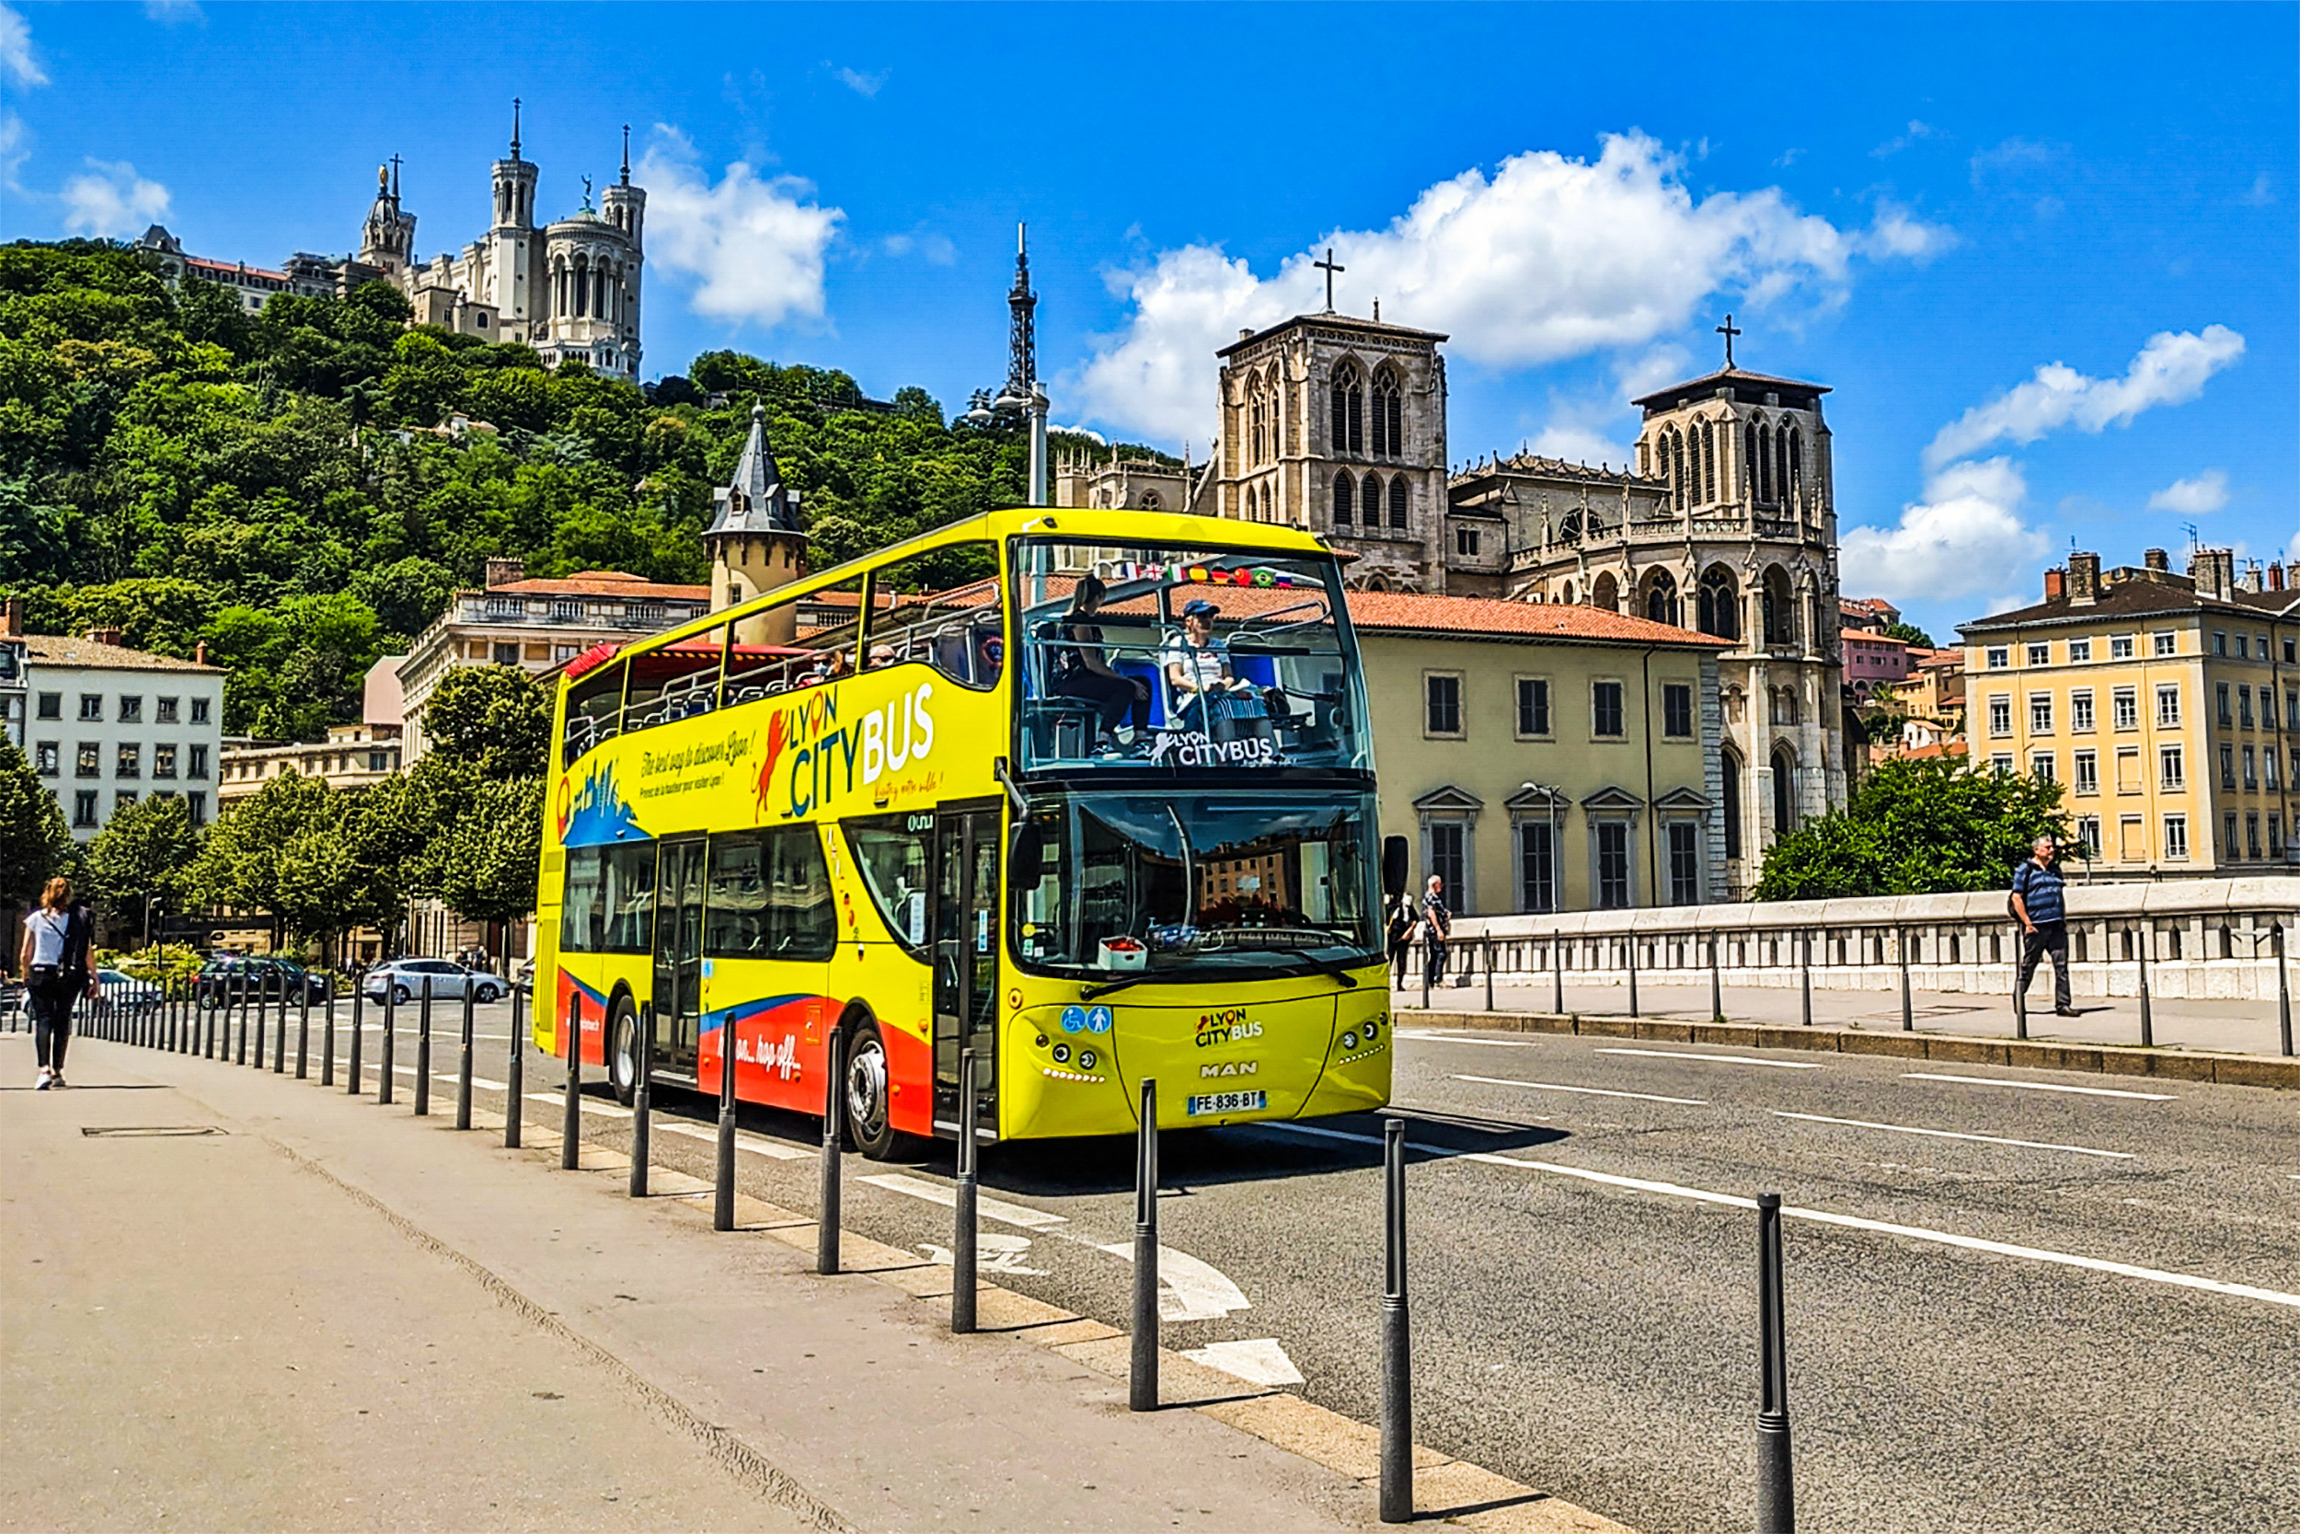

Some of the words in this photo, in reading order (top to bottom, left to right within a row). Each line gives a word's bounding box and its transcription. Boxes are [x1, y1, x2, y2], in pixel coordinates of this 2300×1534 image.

[790, 684, 838, 750] LYON
[791, 683, 934, 818] CITYBUS
[1174, 731, 1210, 747] LYON
[1179, 737, 1274, 765] CITYBUS
[1210, 1008, 1247, 1027] LYON
[1195, 1021, 1263, 1048] CITYBUS
[756, 1034, 776, 1072] hop
[1200, 1061, 1258, 1079] MAN
[1196, 1091, 1258, 1110] FE-836-BT
